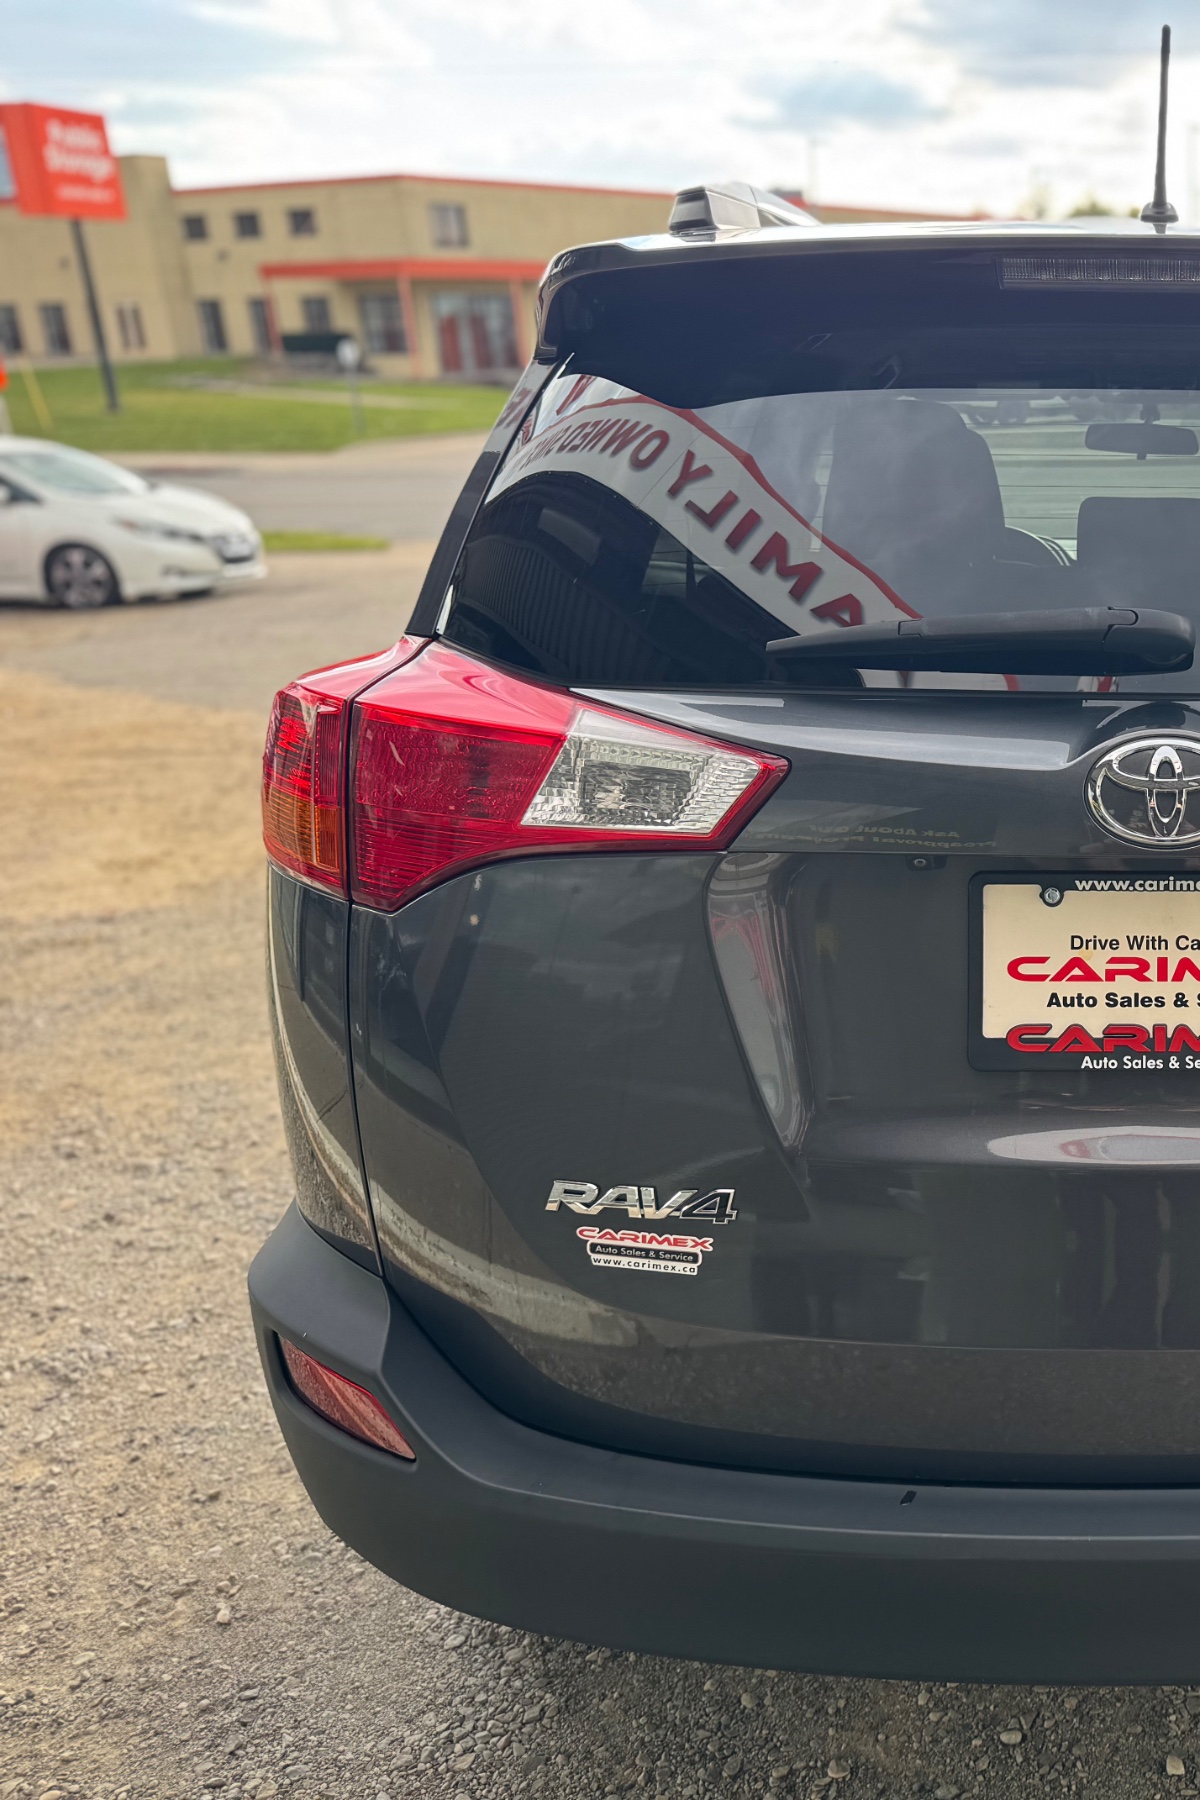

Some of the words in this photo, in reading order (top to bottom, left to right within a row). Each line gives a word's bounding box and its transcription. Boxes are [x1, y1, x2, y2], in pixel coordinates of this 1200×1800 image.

[1070, 935, 1120, 951] Drive
[1125, 935, 1169, 951] With
[1046, 992, 1098, 1008] Auto
[1105, 992, 1166, 1008] Sales
[1173, 992, 1190, 1008] &
[1080, 1056, 1118, 1069] Auto
[1123, 1056, 1164, 1069] Sales
[1168, 1056, 1181, 1069] &
[545, 1179, 738, 1225] RAV4
[577, 1228, 712, 1250] CARIMEX
[594, 1244, 618, 1255] Auto
[620, 1247, 646, 1258] Sales
[648, 1250, 656, 1259] &
[659, 1251, 694, 1262] Service
[592, 1255, 696, 1274] www.carimex.ca
